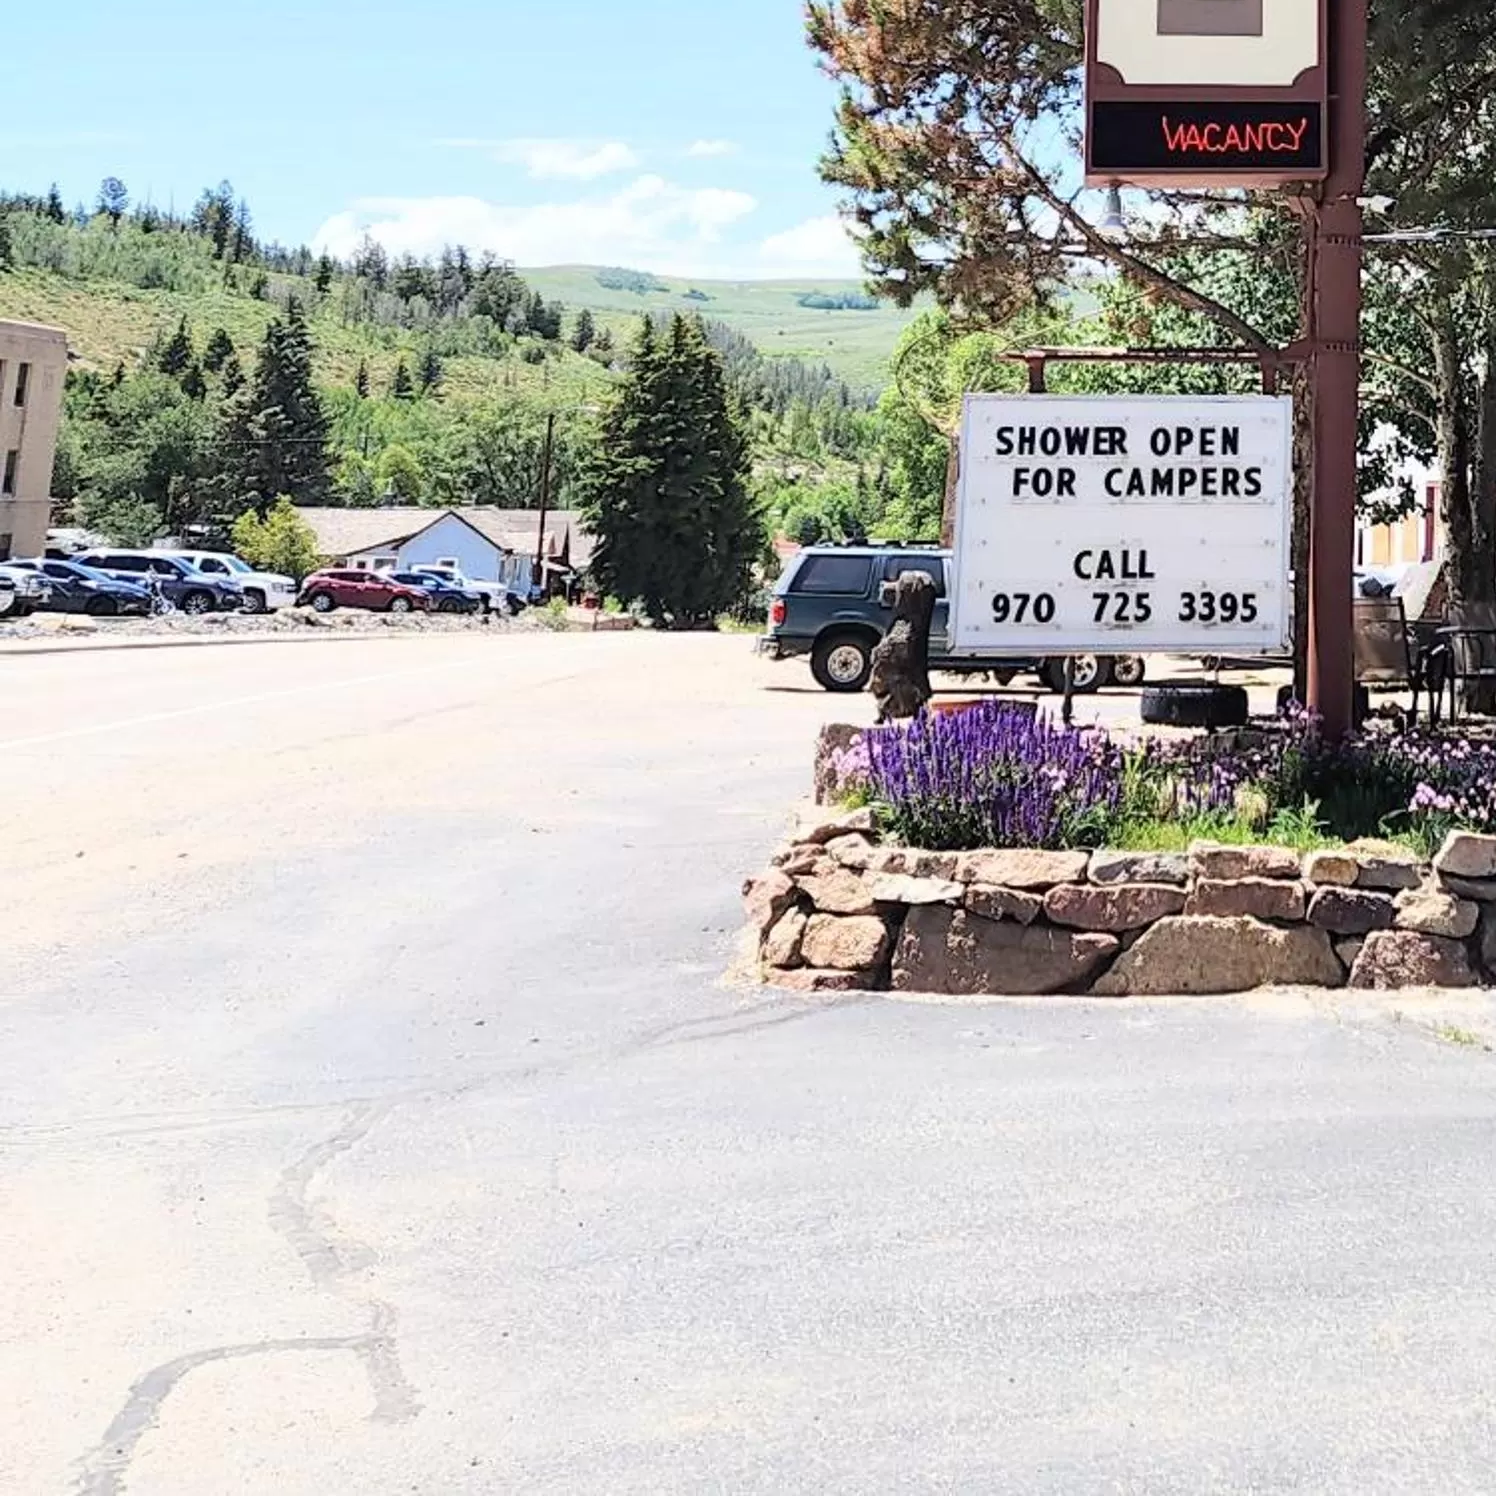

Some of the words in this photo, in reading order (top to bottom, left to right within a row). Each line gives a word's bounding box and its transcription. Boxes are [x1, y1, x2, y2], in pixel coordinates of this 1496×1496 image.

[1161, 115, 1308, 152] VACANCY
[995, 426, 1128, 456] SHOWER
[1149, 426, 1240, 456] OPEN
[1012, 467, 1077, 497] FOR
[1103, 467, 1263, 497] CAMPERS
[1073, 549, 1155, 580] CALL
[991, 592, 1056, 623] 970
[1091, 592, 1152, 623] 725
[1178, 592, 1258, 623] 3395
